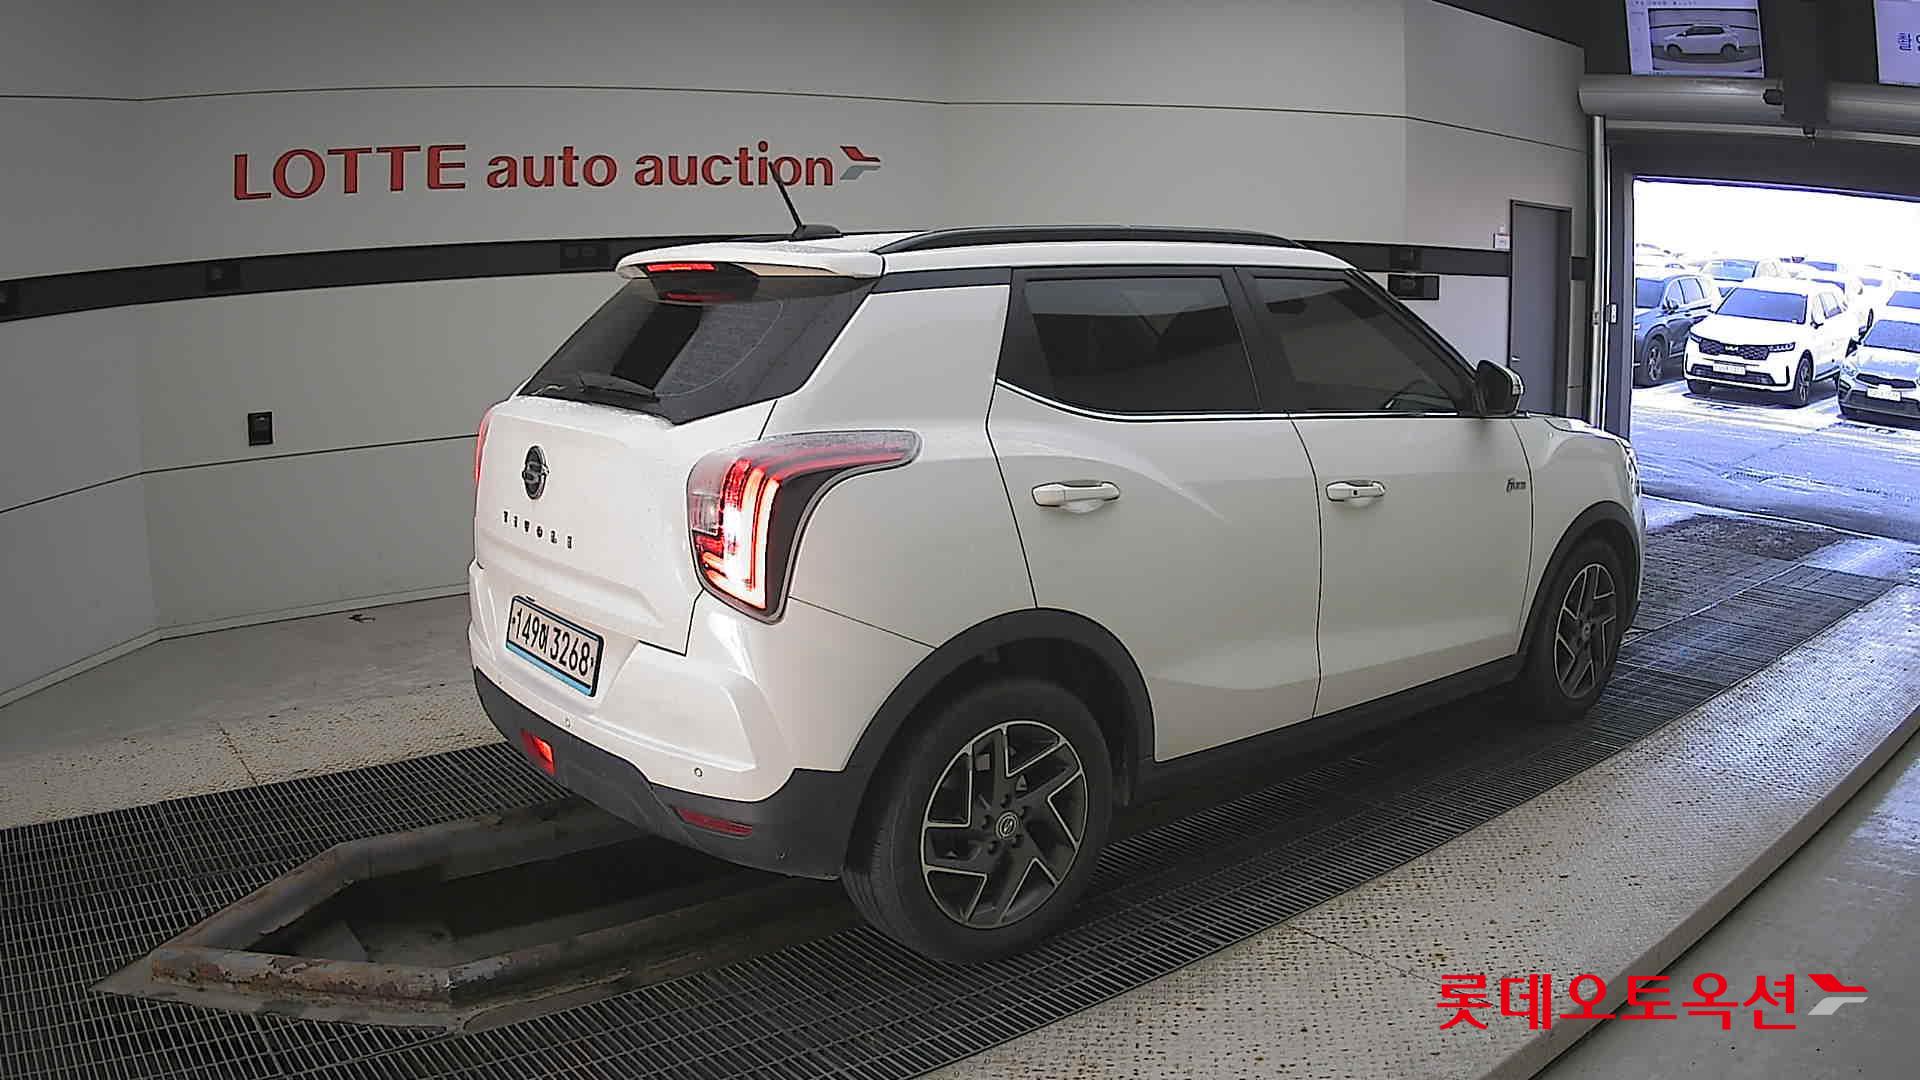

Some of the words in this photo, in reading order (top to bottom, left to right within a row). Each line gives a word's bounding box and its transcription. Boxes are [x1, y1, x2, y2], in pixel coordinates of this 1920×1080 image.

[233, 144, 467, 201] LOTTE
[486, 146, 618, 189] auto
[634, 141, 834, 188] auction
[549, 625, 591, 677] 3268
